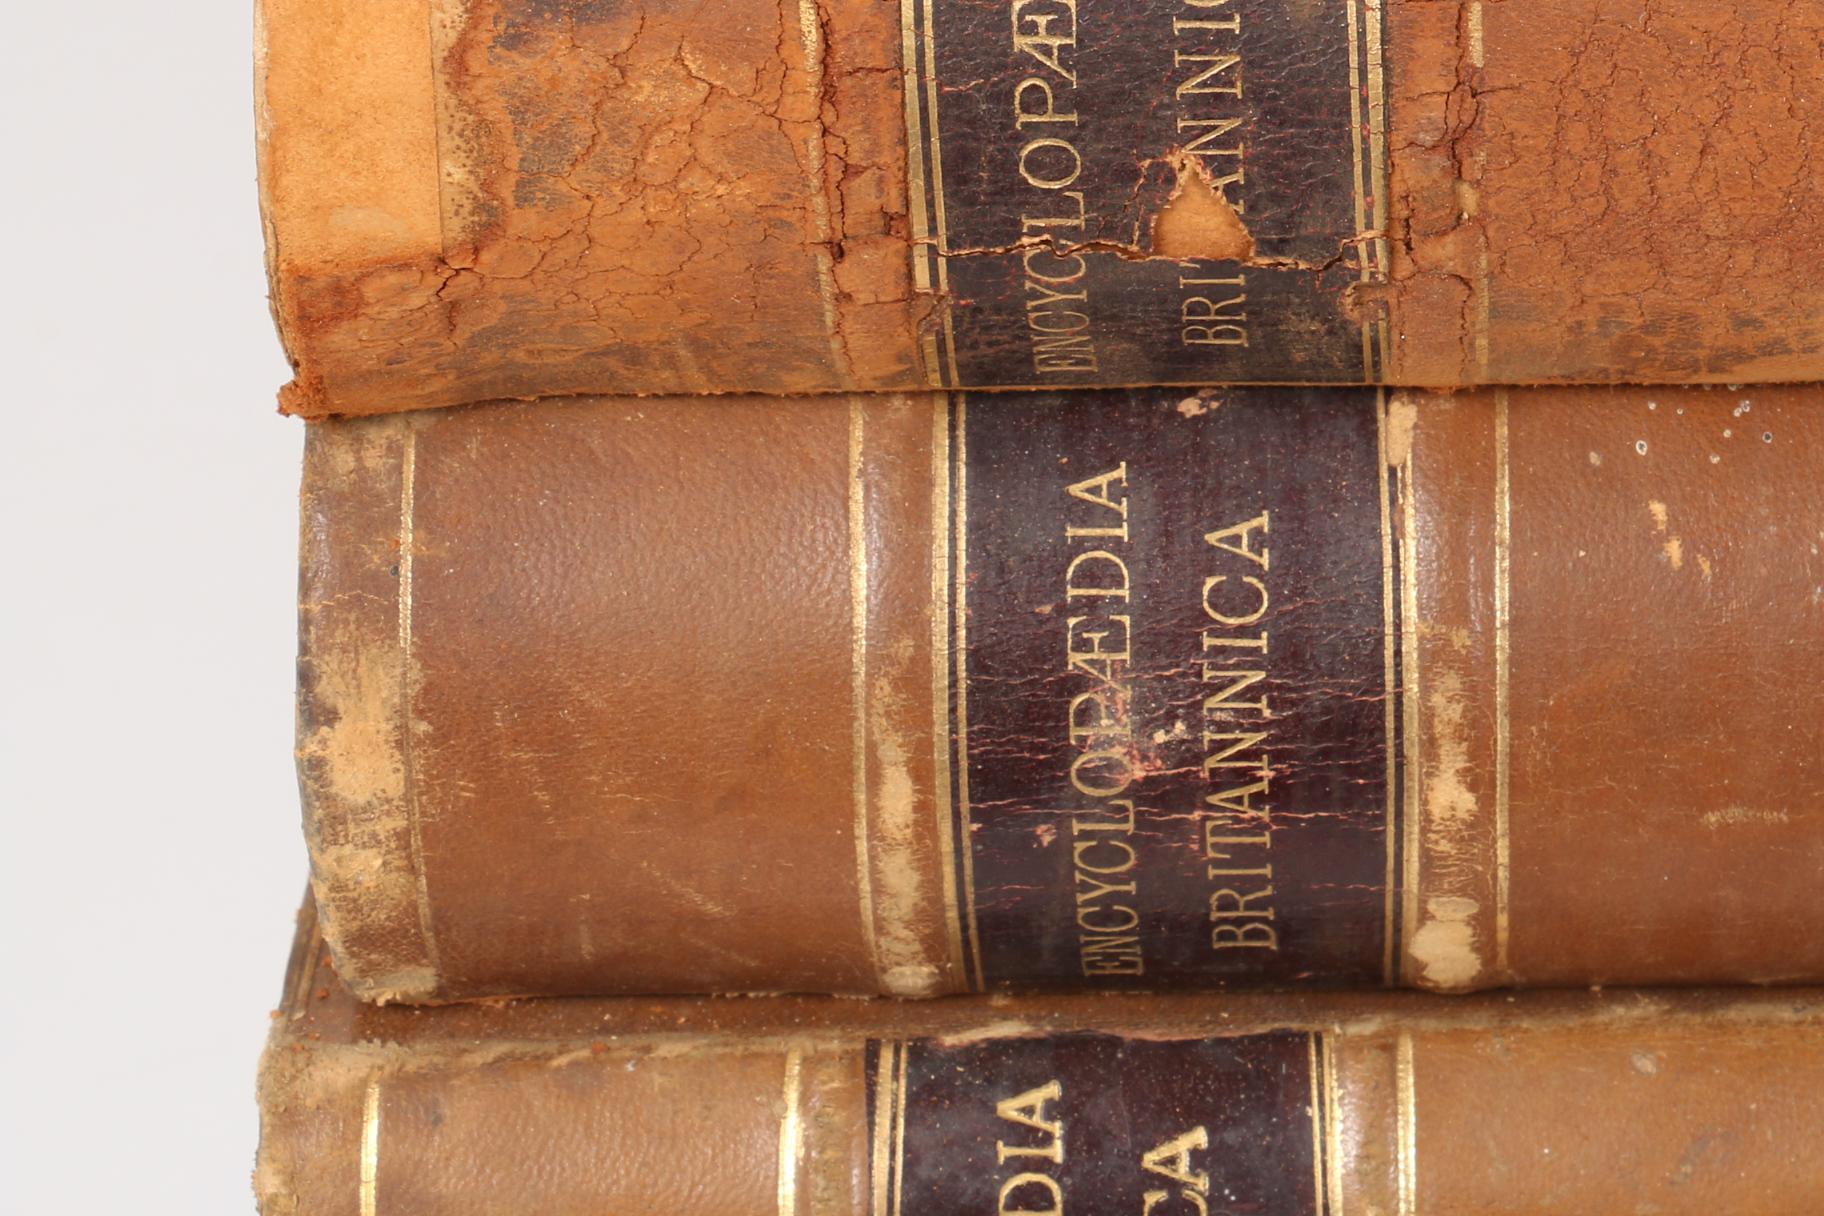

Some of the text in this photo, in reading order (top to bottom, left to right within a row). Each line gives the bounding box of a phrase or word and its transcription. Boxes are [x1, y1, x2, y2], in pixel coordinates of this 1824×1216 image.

[1065, 460, 1144, 977] ENCYCLOPÆDIA
[1202, 510, 1278, 950] BRITANNICA
[996, 1080, 1064, 1216] DIA
